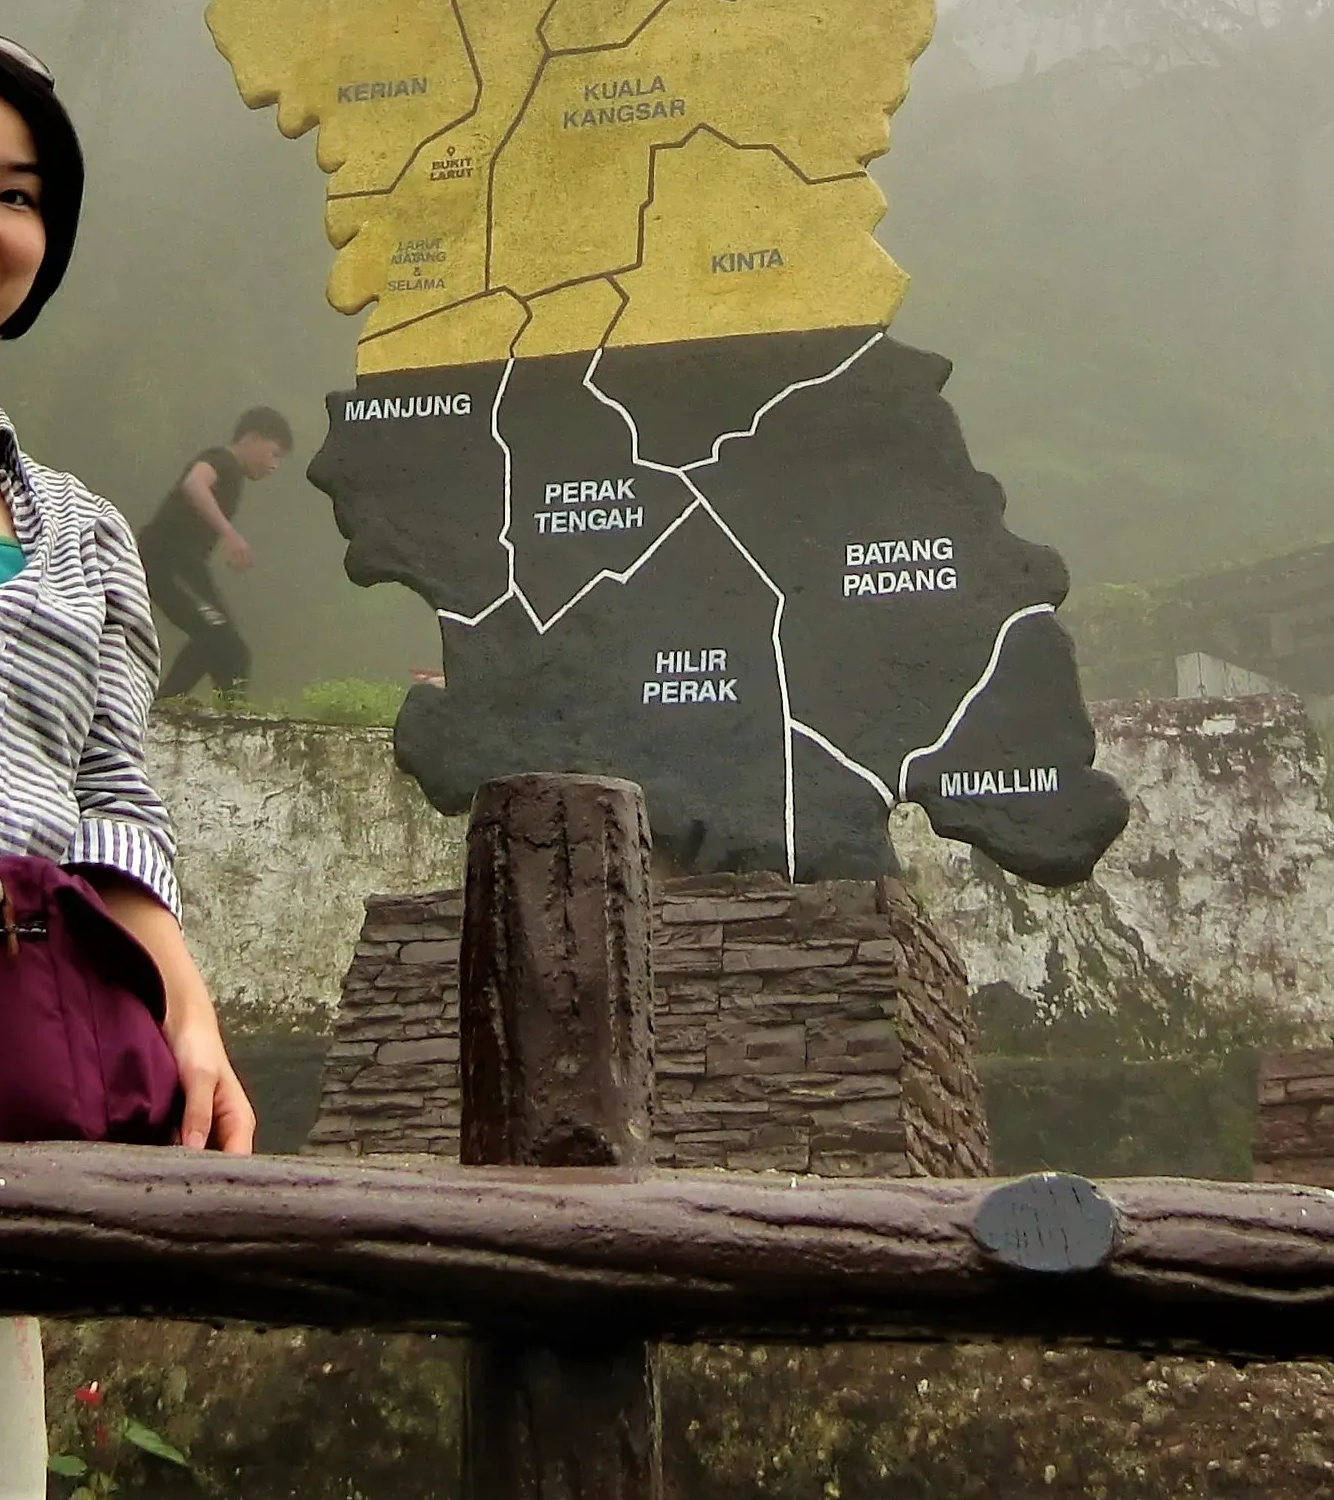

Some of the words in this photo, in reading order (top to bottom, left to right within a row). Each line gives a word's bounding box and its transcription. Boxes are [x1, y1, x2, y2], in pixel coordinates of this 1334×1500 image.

[337, 77, 427, 103] KERIAN
[584, 76, 666, 100] KUALA
[562, 99, 686, 129] KANGSAR
[430, 168, 474, 181] LARUT
[431, 158, 472, 170] BUKIT
[711, 249, 784, 274] KINTA
[388, 278, 445, 291] SELAMA
[344, 393, 472, 421] MANJUNG
[544, 478, 636, 505] PERAK
[534, 506, 645, 534] TENGAH
[845, 537, 953, 566] BATANG
[843, 567, 958, 596] PADANG
[655, 649, 727, 674] HILIR
[642, 676, 737, 704] PERAK
[941, 767, 1058, 796] MUALLIM
